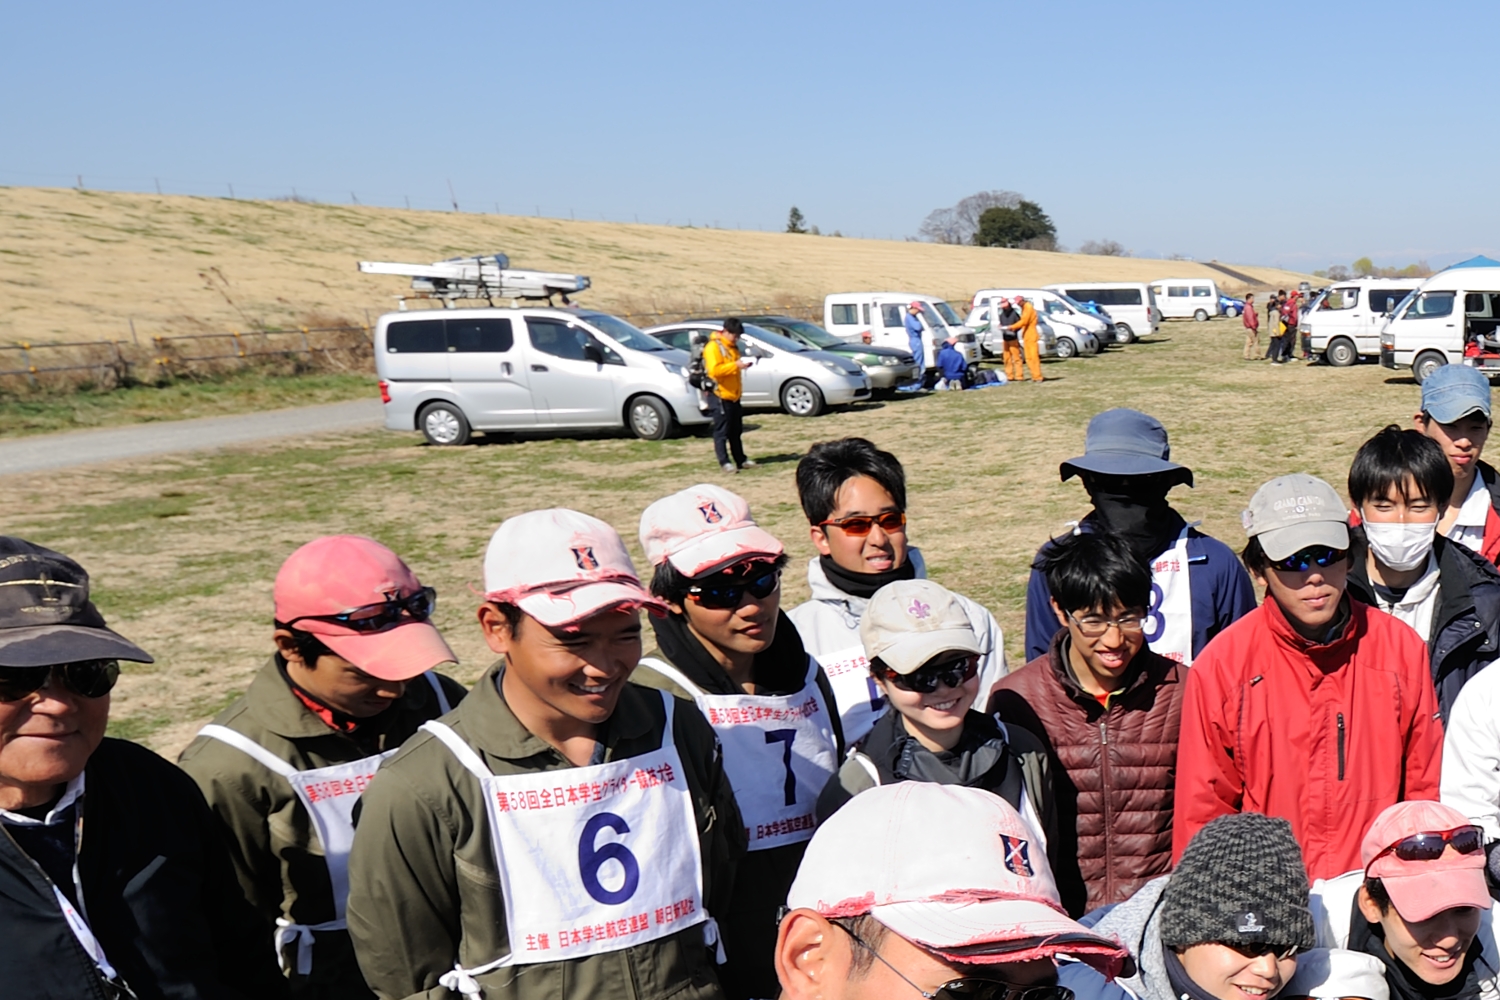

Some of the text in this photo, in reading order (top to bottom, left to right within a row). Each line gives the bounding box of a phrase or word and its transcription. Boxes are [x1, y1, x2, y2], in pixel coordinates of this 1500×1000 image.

[765, 729, 797, 807] 7
[578, 811, 640, 906] 6
[525, 896, 696, 952] 主催 日本学生航空連盟 朝日新聞社
